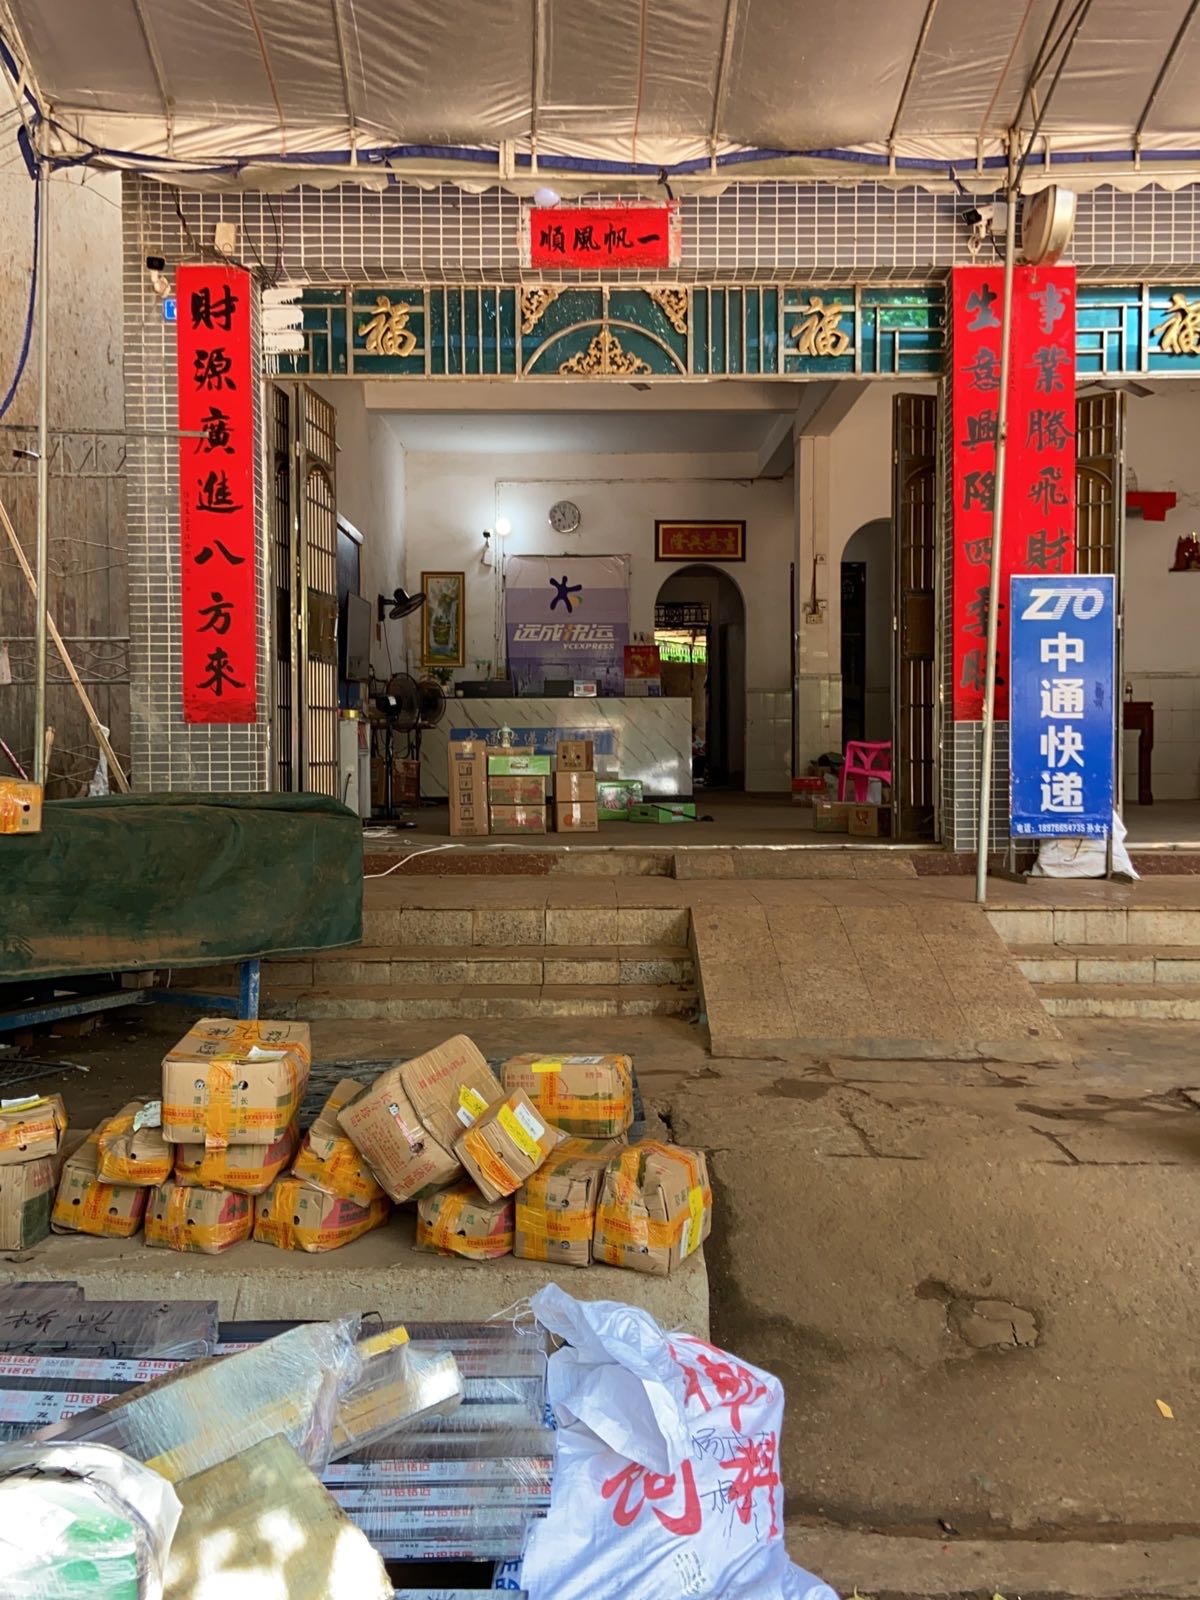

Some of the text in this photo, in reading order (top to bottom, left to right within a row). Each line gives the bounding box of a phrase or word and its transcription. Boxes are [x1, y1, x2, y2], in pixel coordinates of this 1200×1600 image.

[358, 295, 417, 357] 福
[791, 295, 849, 357] 福
[1153, 293, 1200, 354] 福
[1021, 588, 1105, 620] ZTO
[1040, 632, 1084, 813] 中通快递
